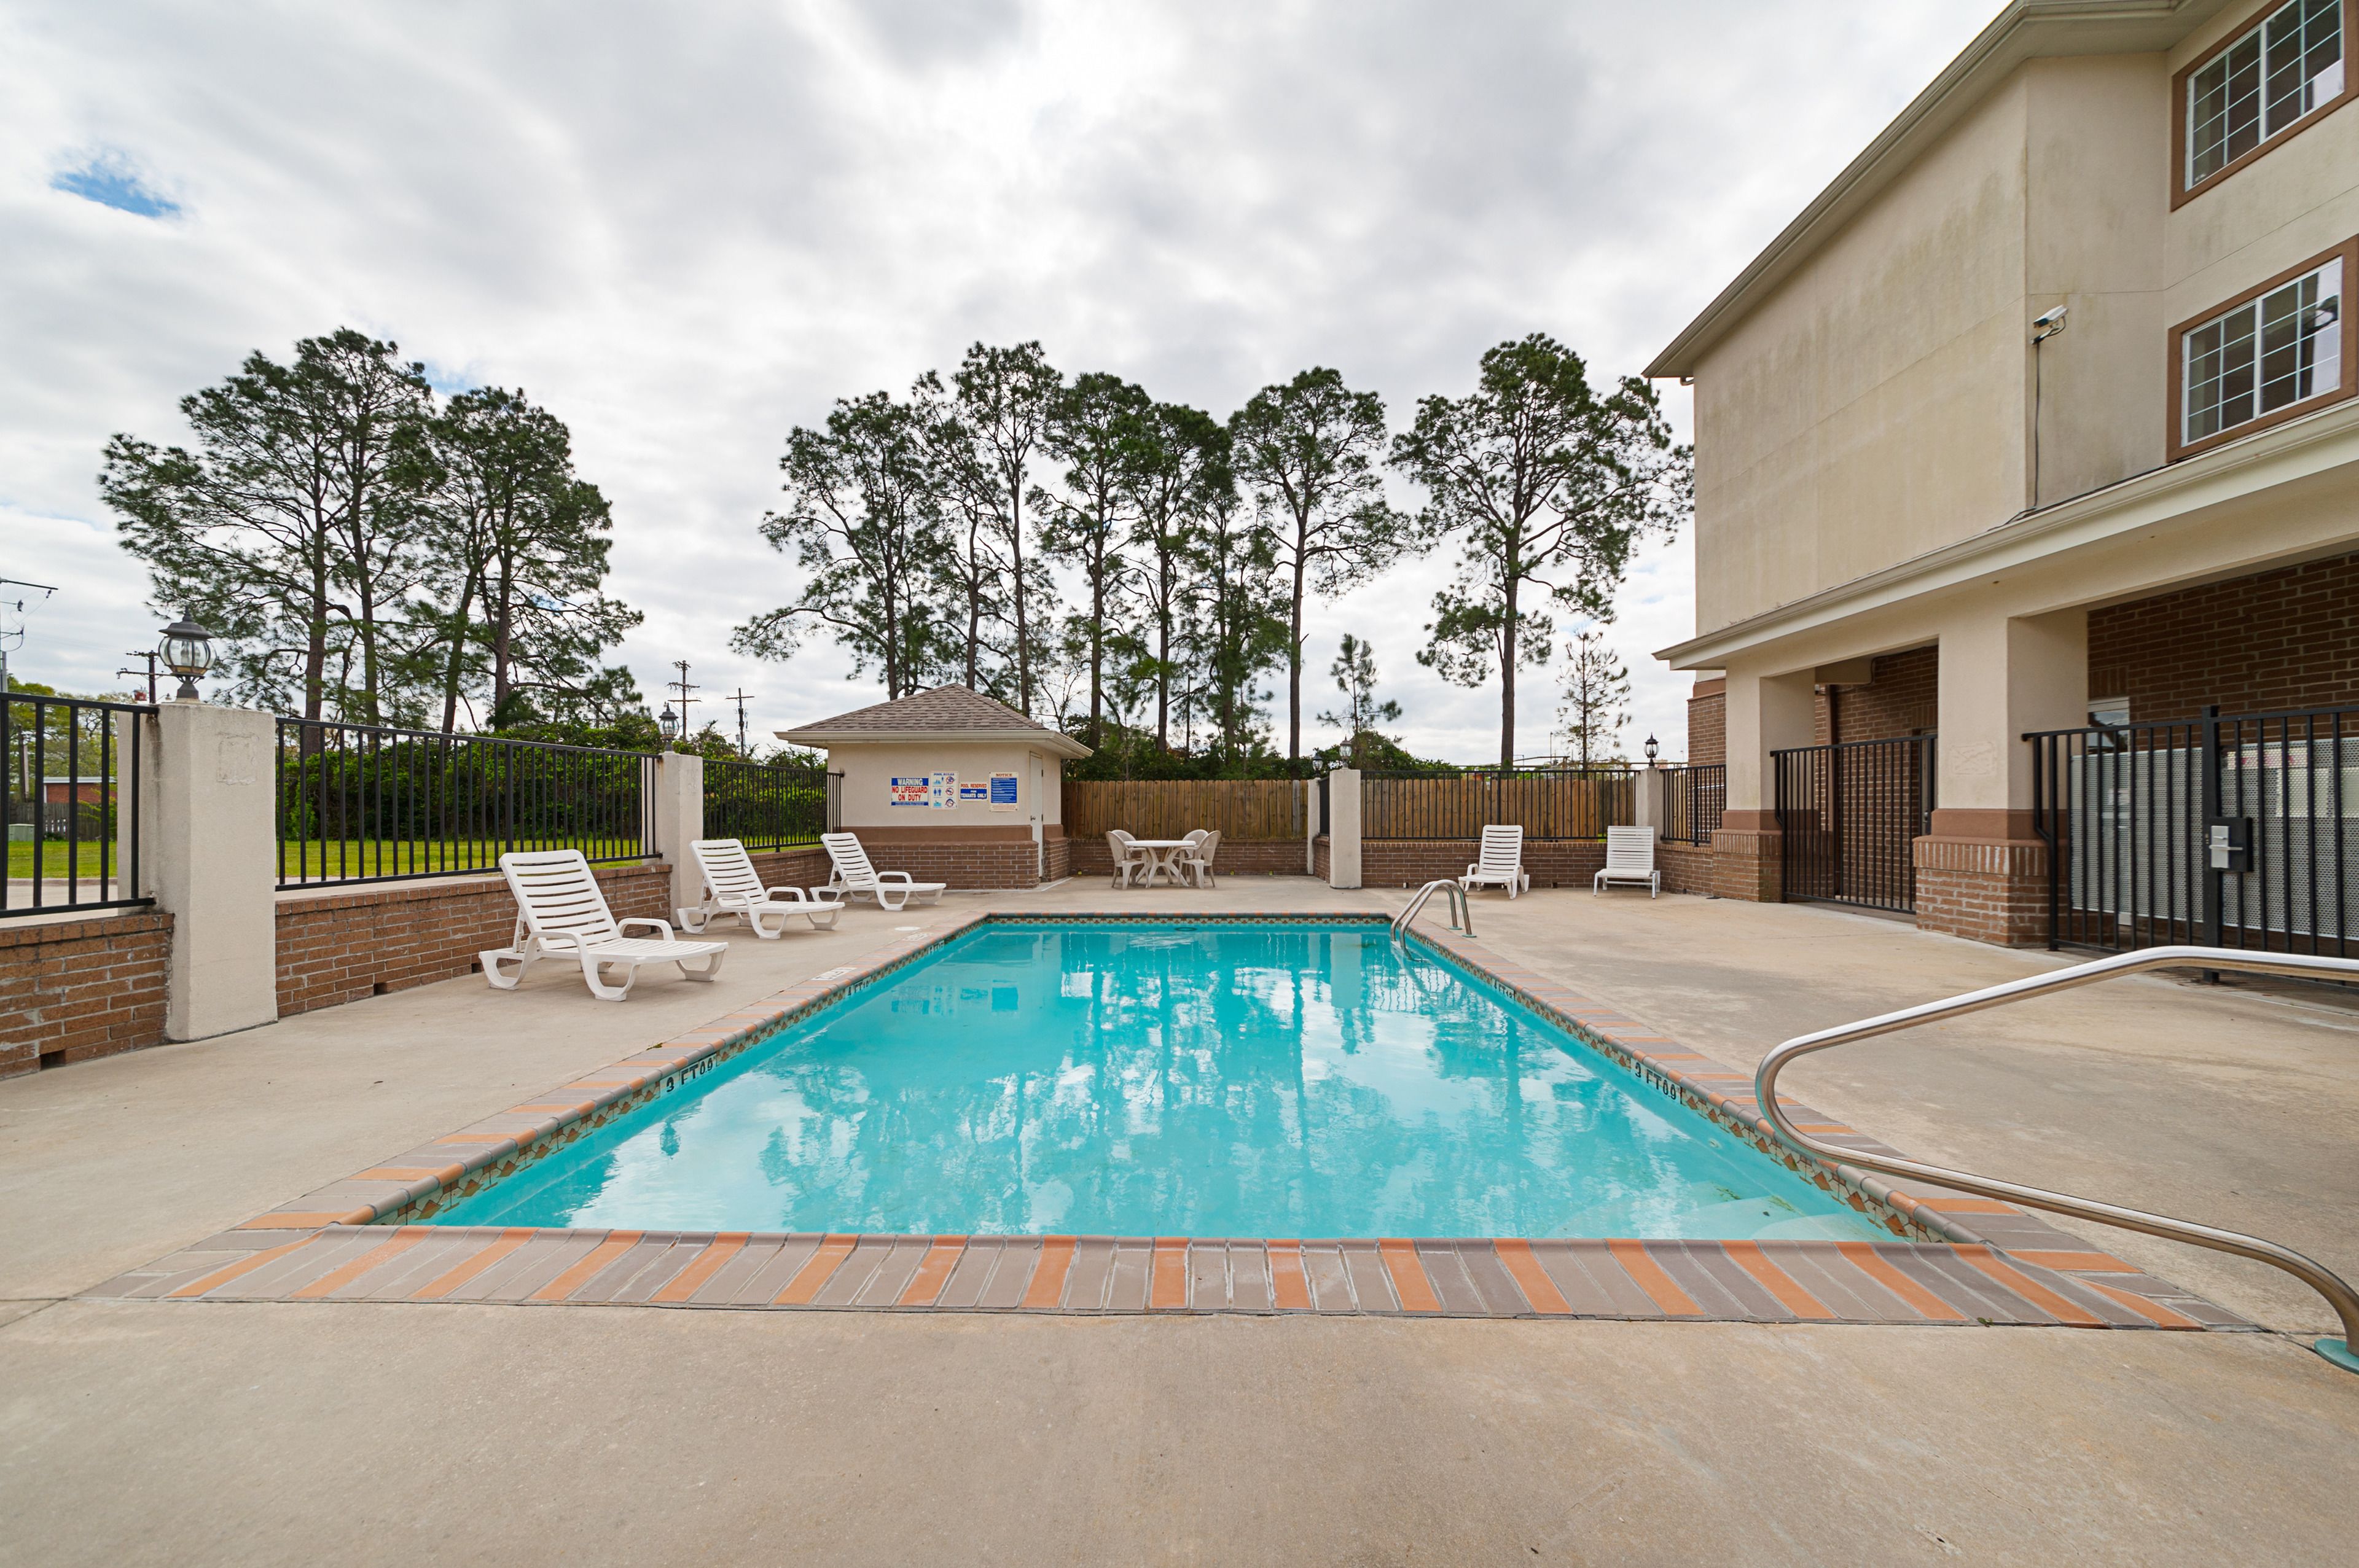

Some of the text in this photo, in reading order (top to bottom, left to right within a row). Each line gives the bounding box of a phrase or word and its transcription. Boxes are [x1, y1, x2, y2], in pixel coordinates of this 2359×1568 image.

[667, 1077, 675, 1093] 3
[681, 1063, 698, 1085] FT
[1635, 1062, 1641, 1078] 3
[1646, 1069, 1661, 1090] FT
